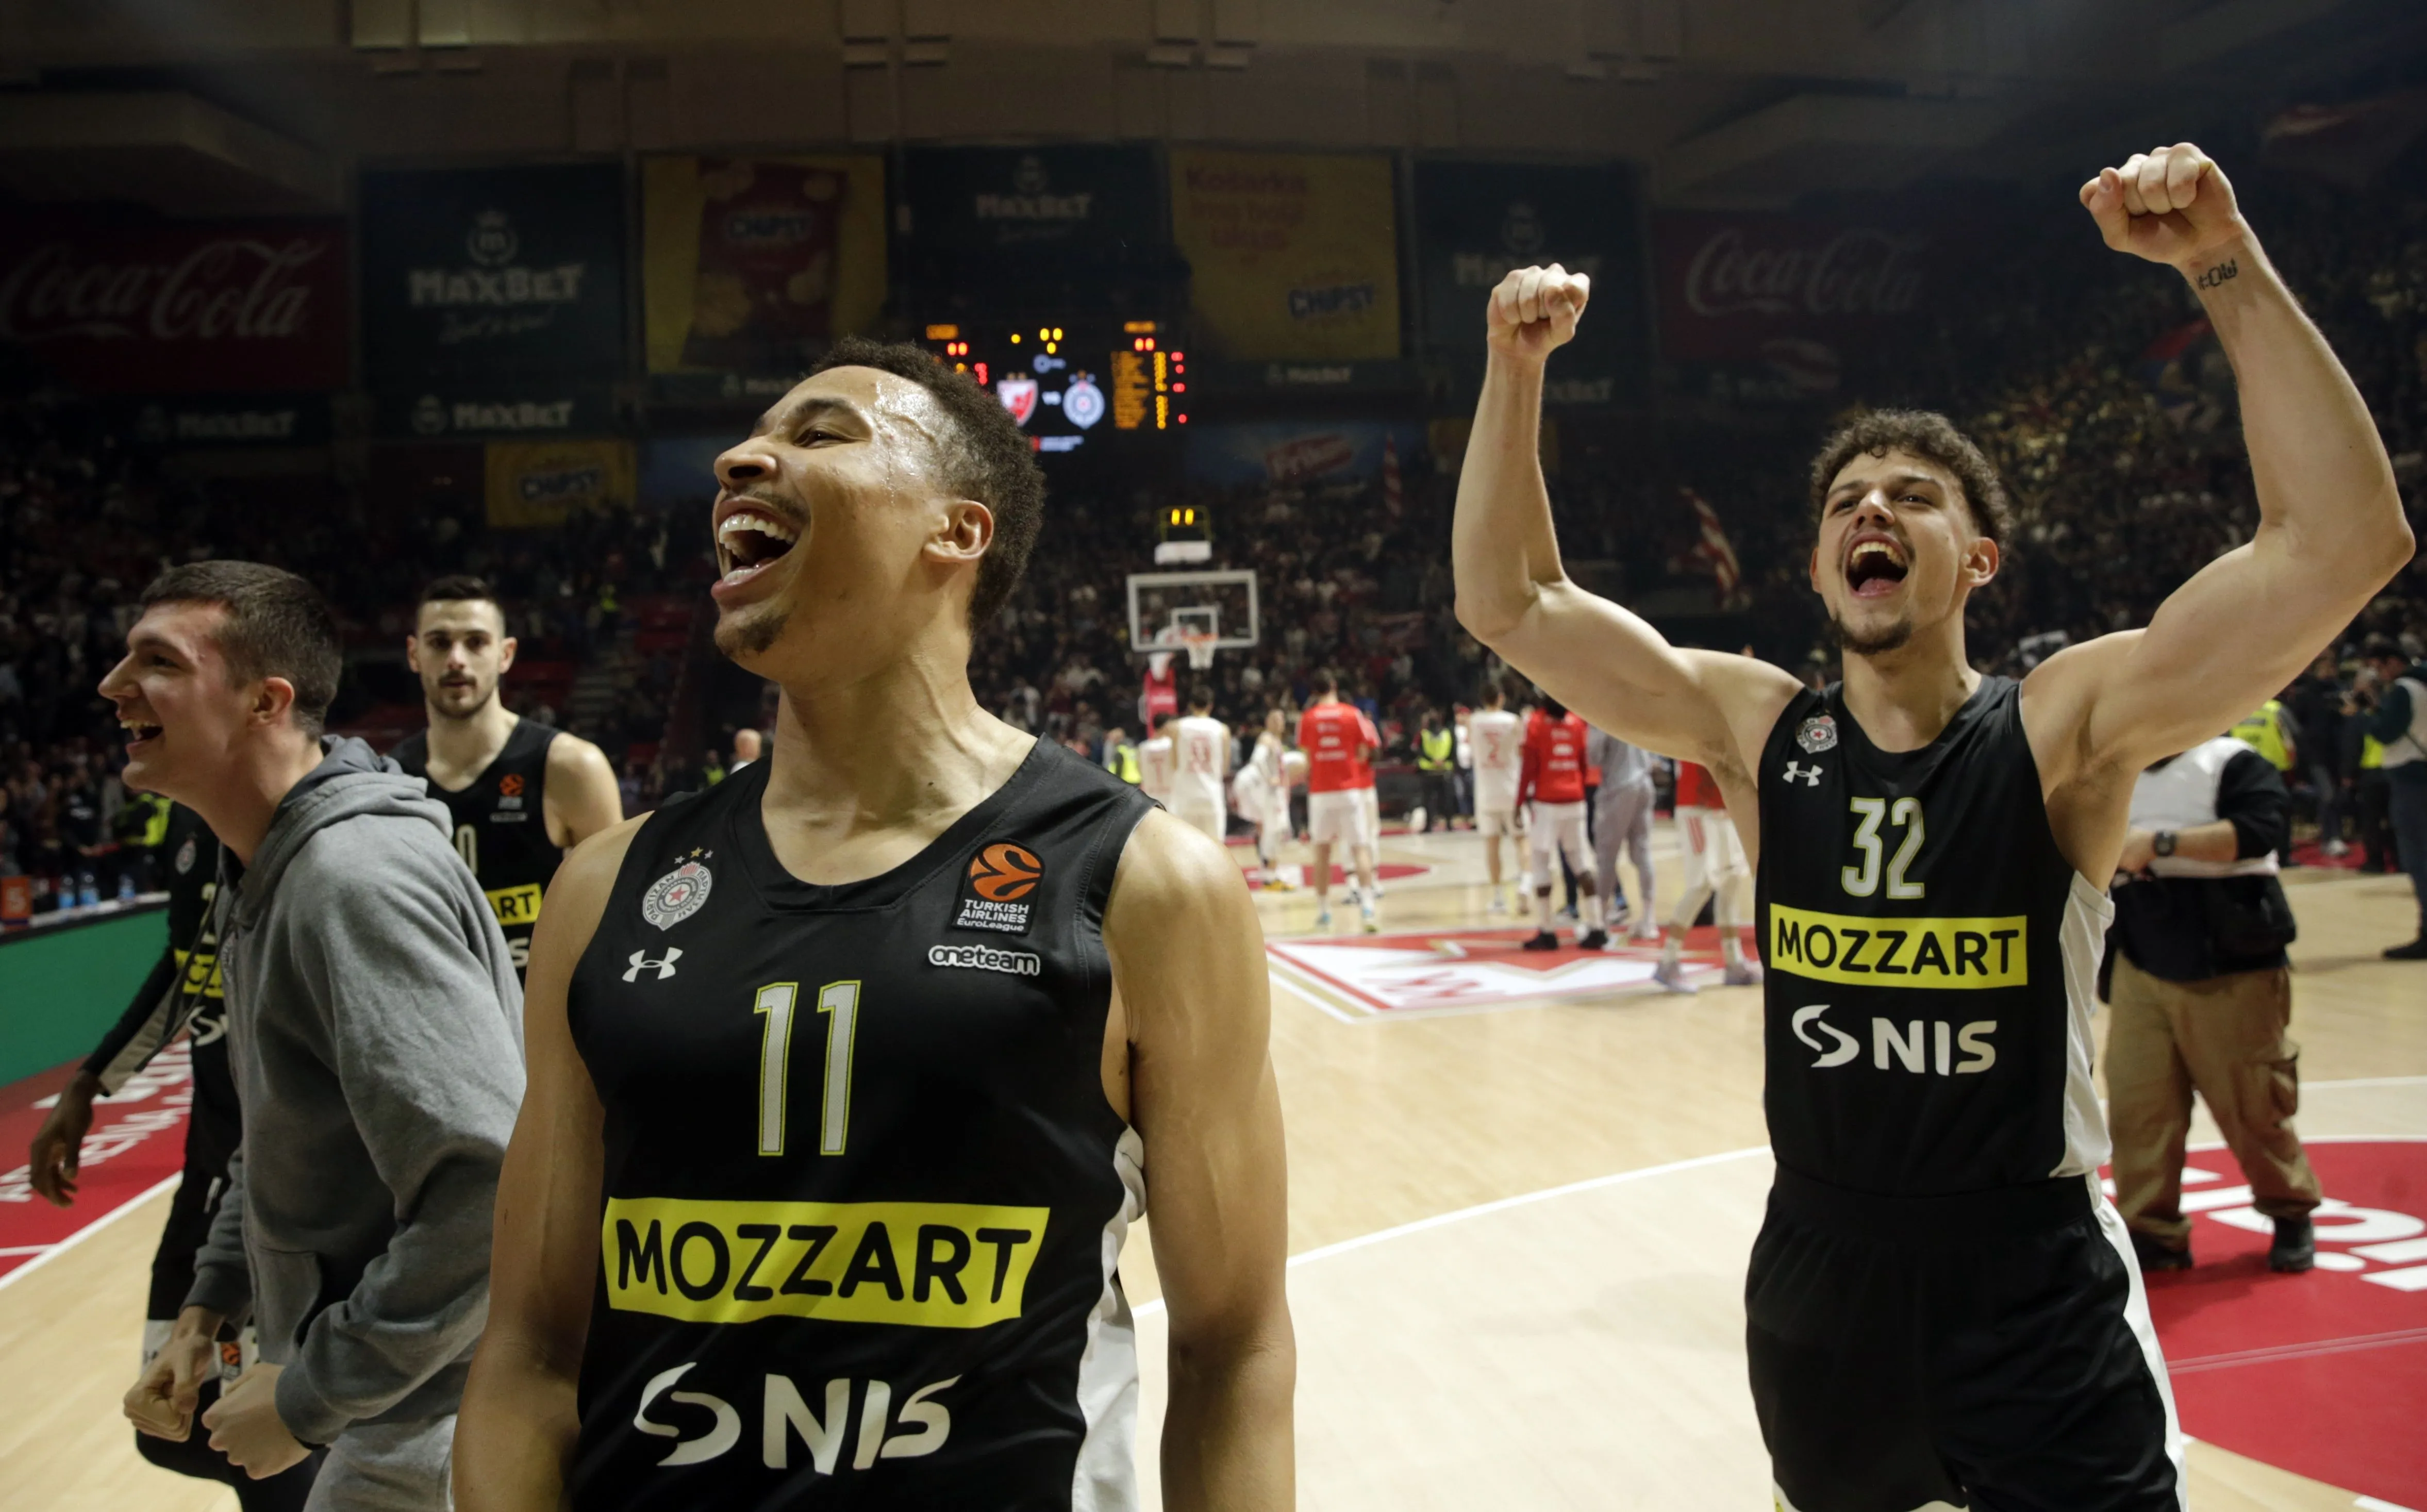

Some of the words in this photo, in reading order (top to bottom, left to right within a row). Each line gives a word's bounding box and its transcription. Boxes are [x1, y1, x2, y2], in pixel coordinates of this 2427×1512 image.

[1841, 797, 1925, 899] 32
[956, 918, 1024, 932] EuroLeague
[960, 909, 1027, 924] AIRLINES
[965, 899, 1029, 915] TURKISH
[929, 945, 1039, 975] oneteam
[1777, 918, 2020, 975] MOZZART
[754, 980, 861, 1156] 11
[1872, 1017, 1998, 1076] NIS
[616, 1219, 1032, 1305] MOZZART
[762, 1373, 963, 1475] NIS
